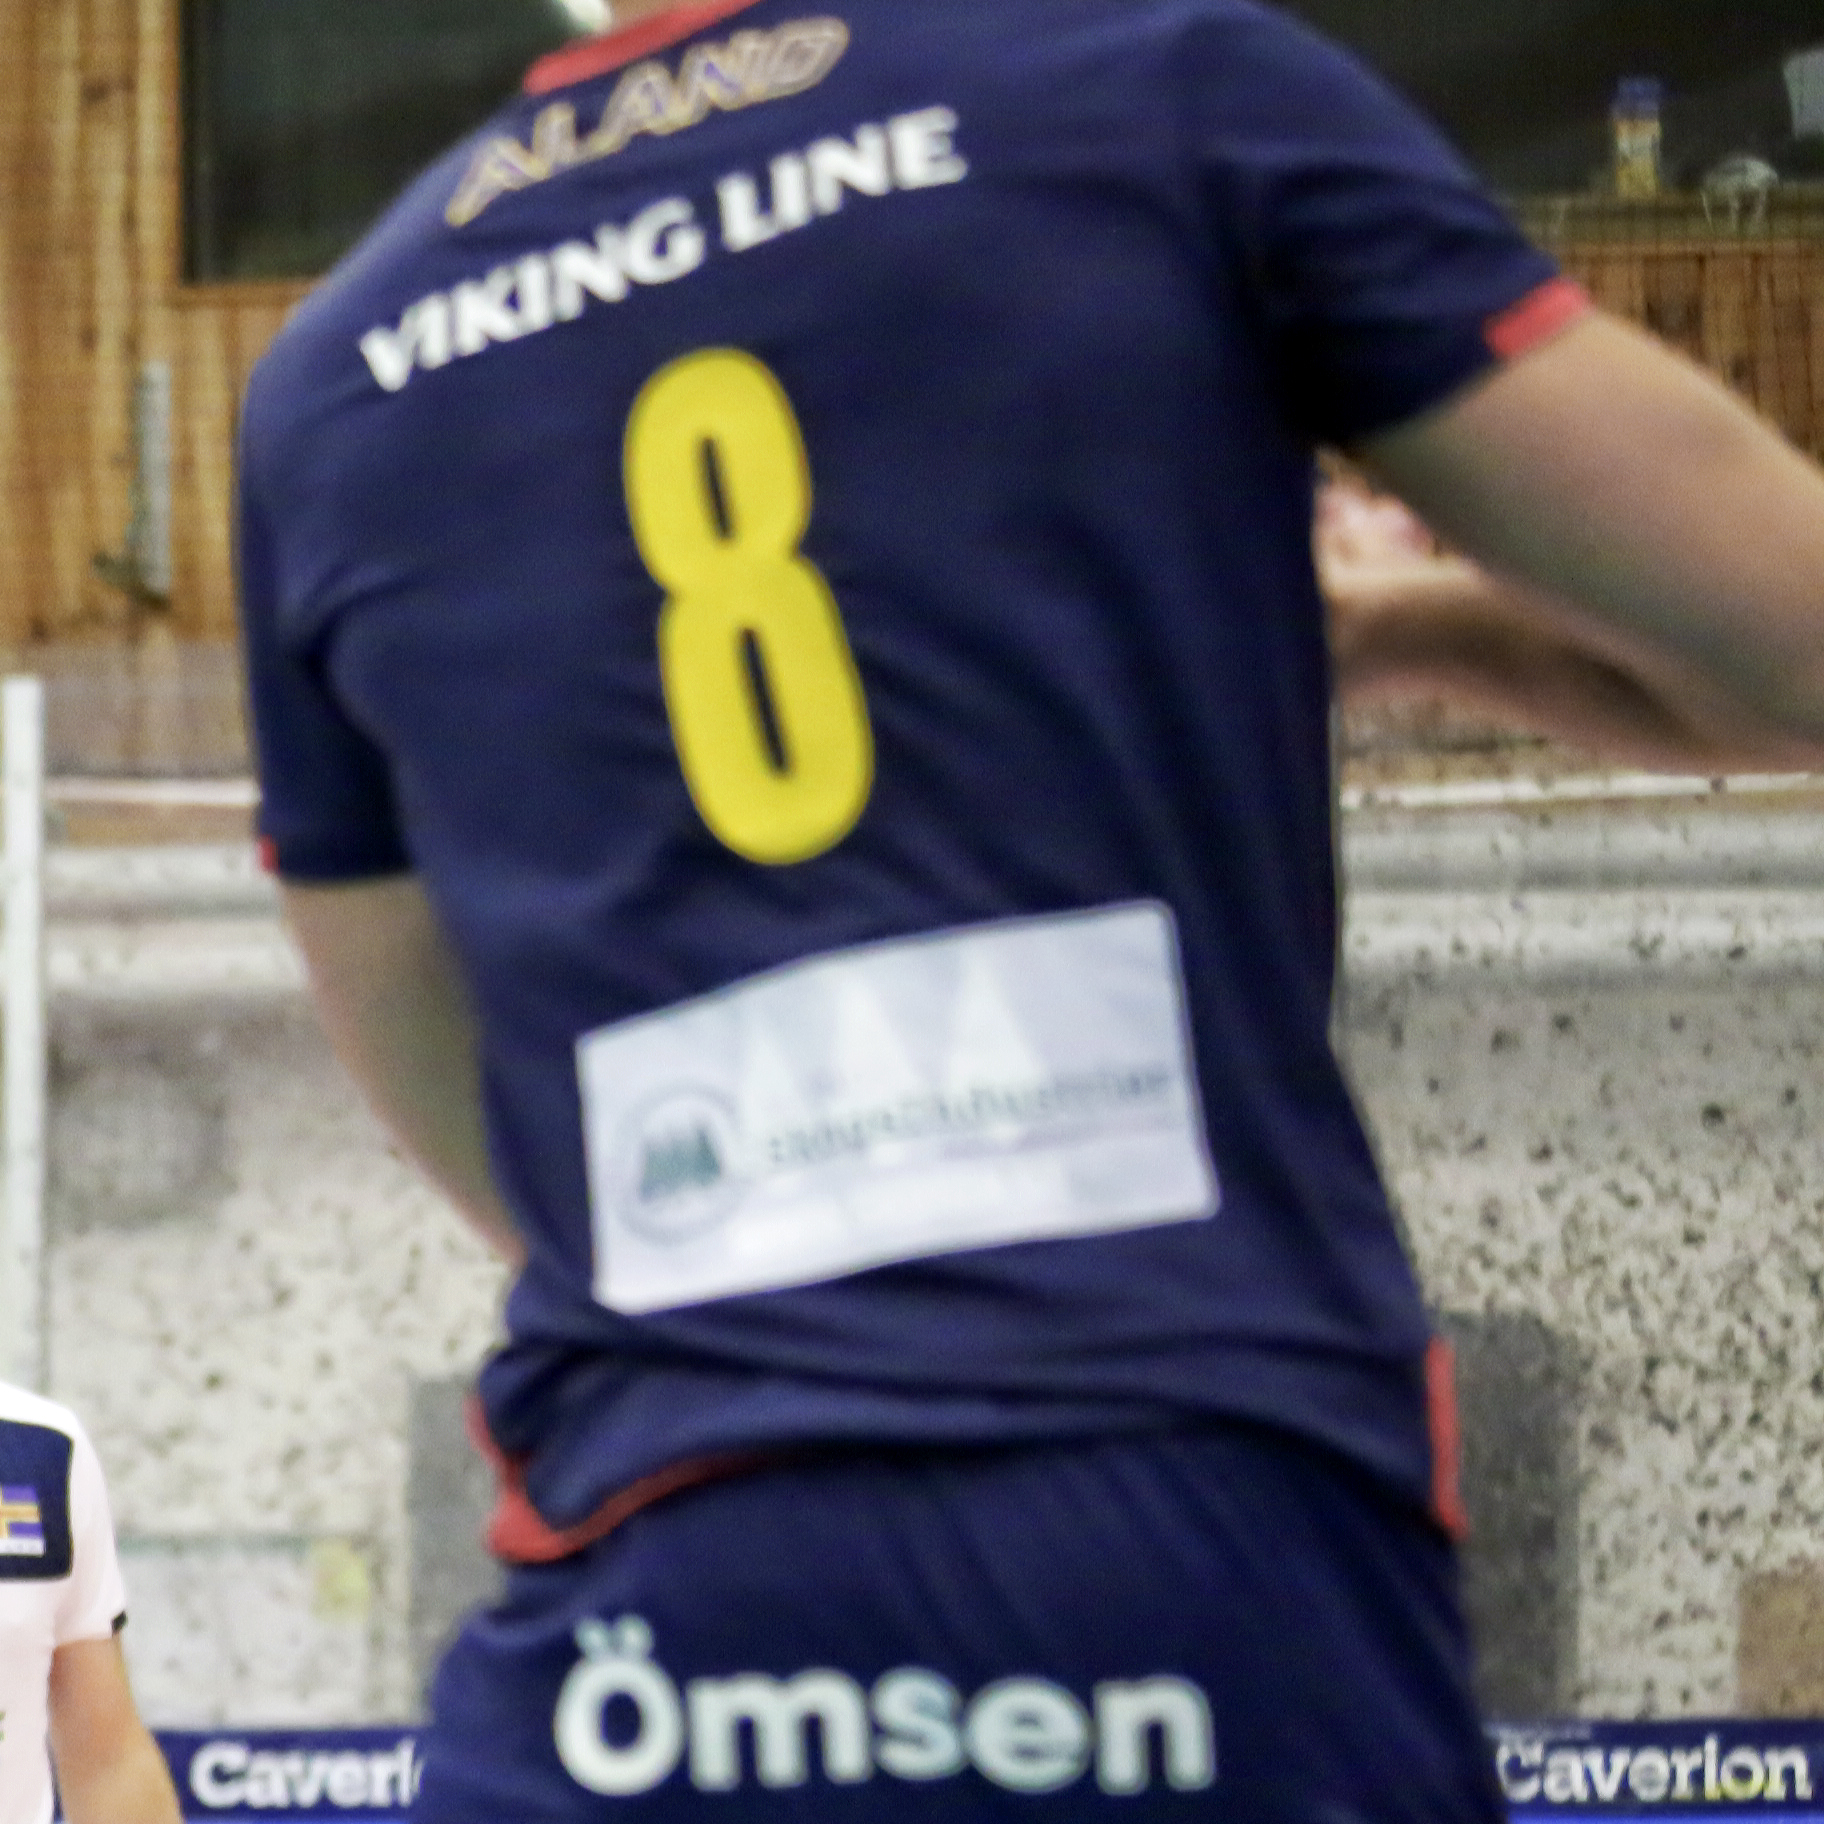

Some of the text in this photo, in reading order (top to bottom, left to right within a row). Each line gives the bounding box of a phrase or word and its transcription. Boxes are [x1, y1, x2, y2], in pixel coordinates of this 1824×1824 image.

[359, 105, 968, 392] VIKING LINE
[622, 346, 875, 866] 8
[188, 1736, 425, 1809] Caveri
[554, 1613, 1216, 1797] Ömsen
[1494, 1732, 1814, 1804] Caverion
